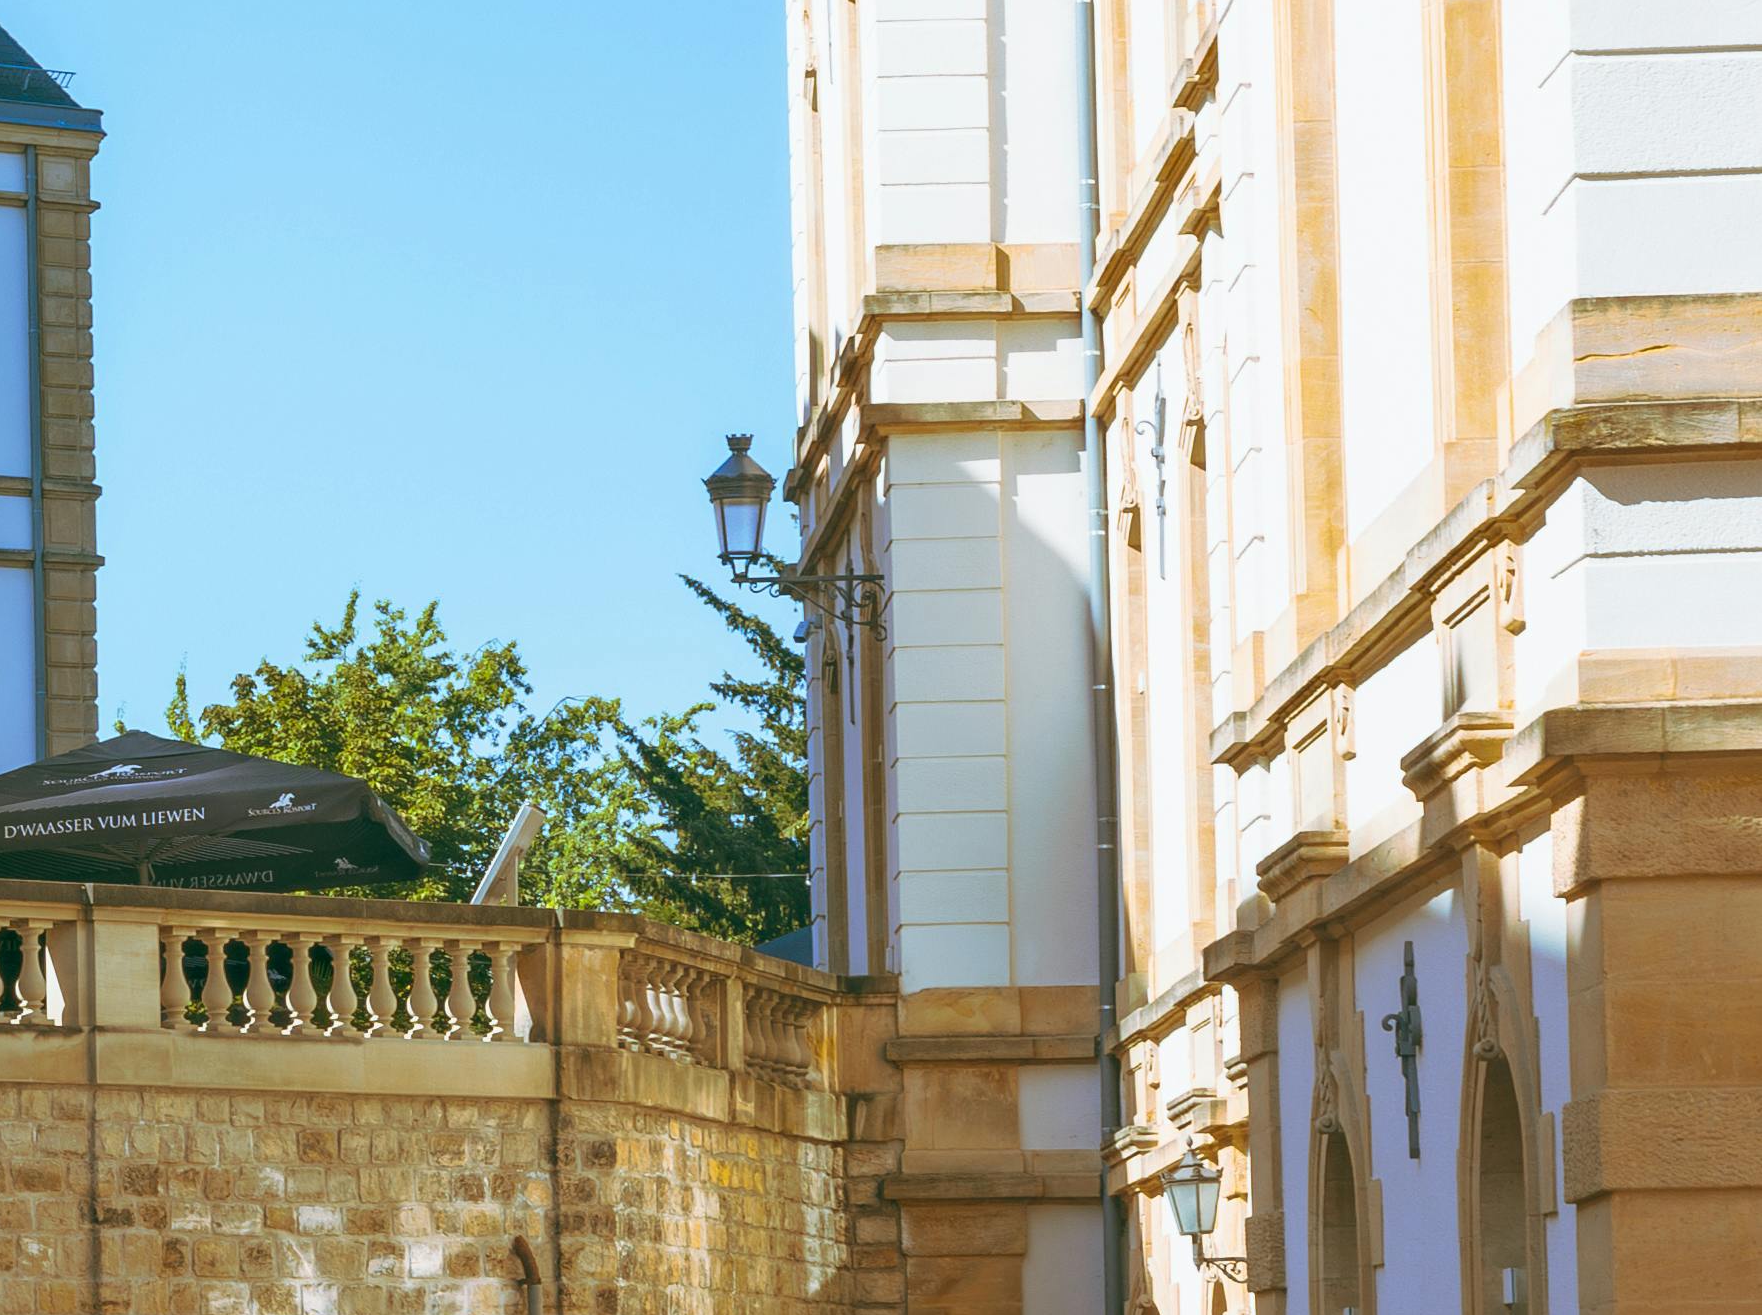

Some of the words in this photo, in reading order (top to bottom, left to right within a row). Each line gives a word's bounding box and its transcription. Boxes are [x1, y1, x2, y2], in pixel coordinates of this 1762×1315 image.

[4, 817, 95, 839] D'WAASSER
[97, 814, 137, 830] VUM
[142, 806, 206, 826] LIEWEN
